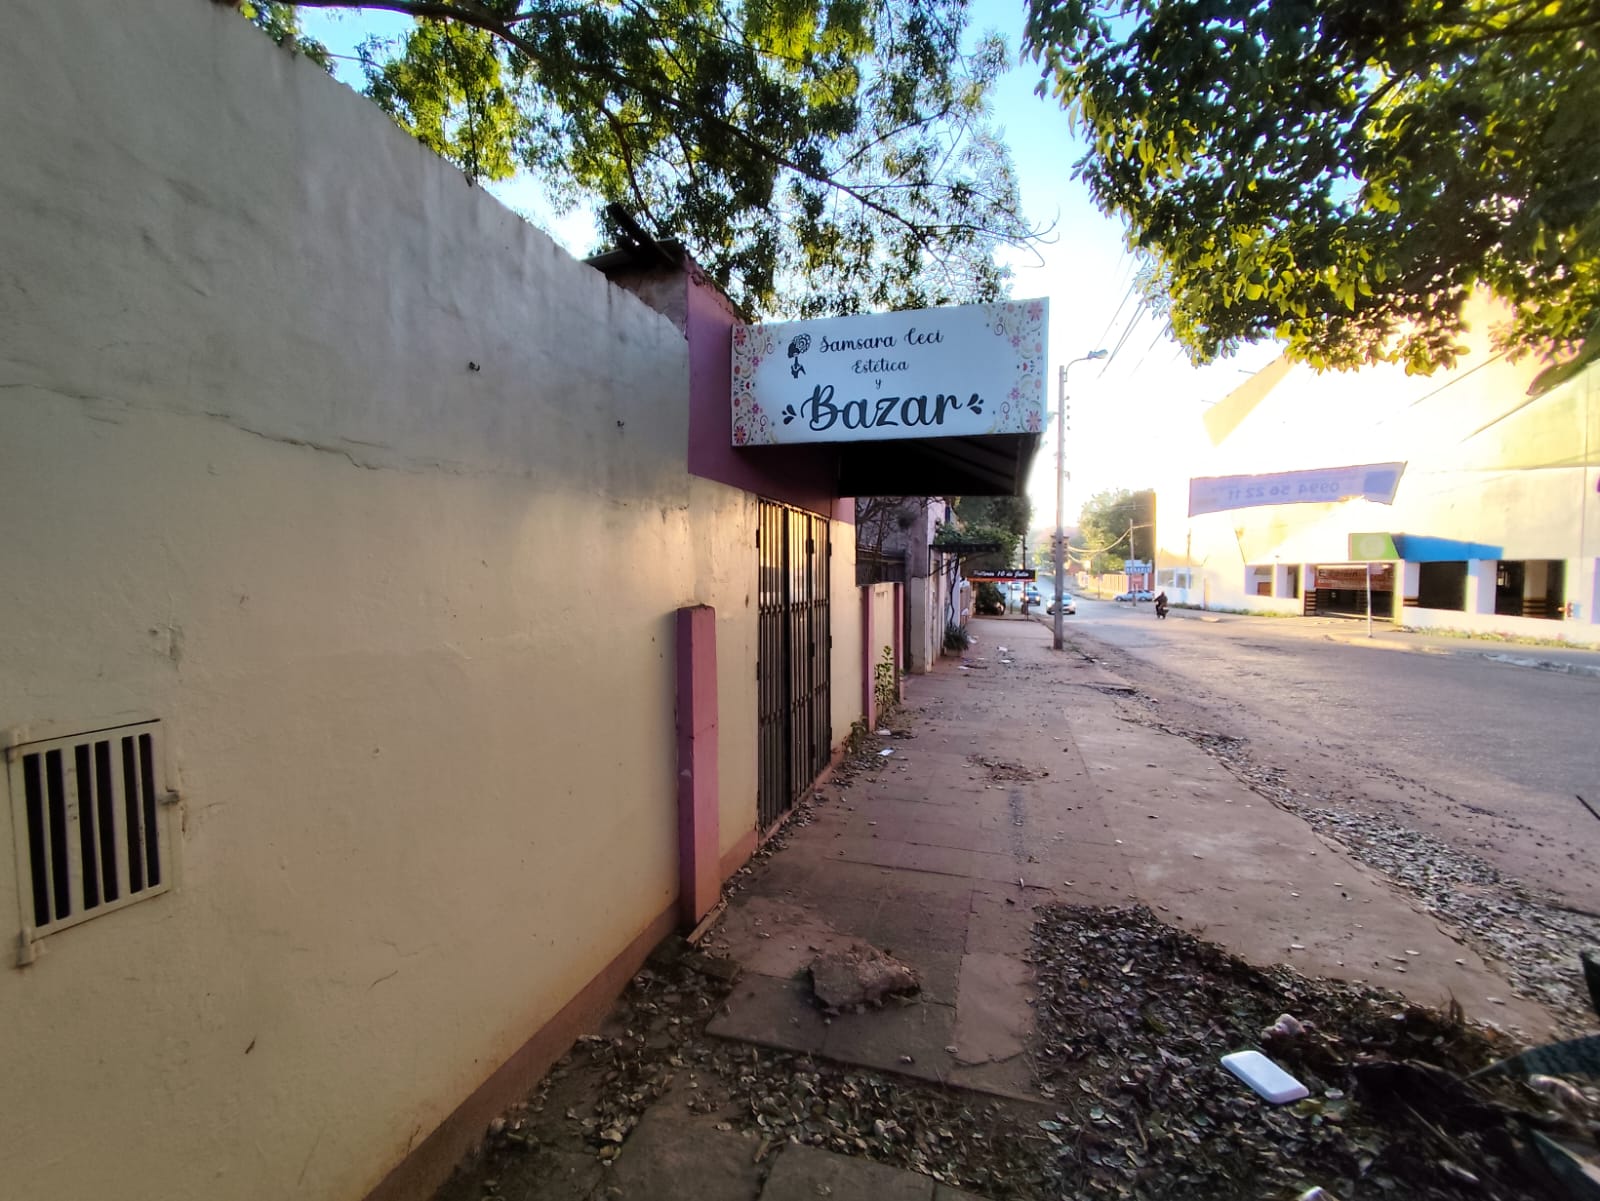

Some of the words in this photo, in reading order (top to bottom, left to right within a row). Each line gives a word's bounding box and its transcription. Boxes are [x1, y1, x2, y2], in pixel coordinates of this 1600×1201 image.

[819, 333, 896, 354] Samsara
[904, 327, 945, 346] Ceci
[851, 359, 910, 374] Estética
[875, 378, 883, 390] y
[801, 384, 963, 432] Bazar
